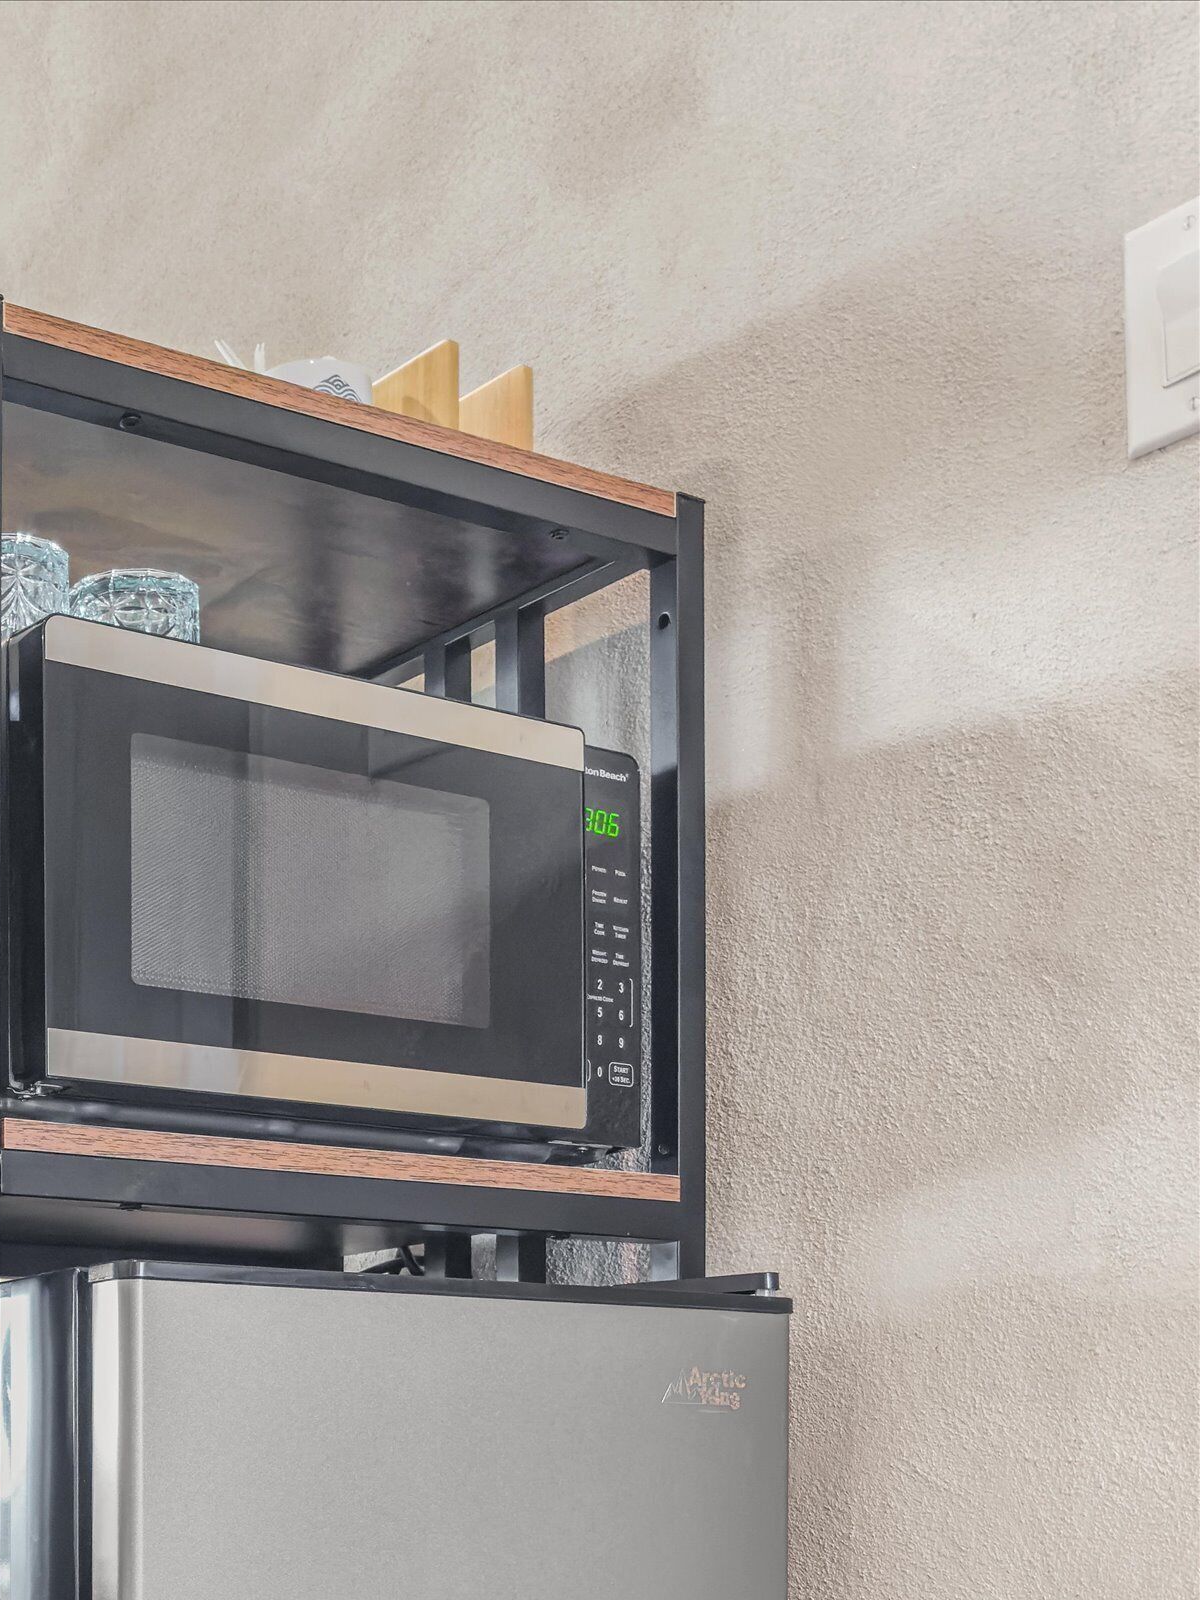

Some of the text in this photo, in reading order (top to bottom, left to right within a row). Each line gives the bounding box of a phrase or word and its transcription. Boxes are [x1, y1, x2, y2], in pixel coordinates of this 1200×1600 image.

[600, 769, 626, 782] Beach
[597, 978, 624, 994] 2 3
[597, 1006, 624, 1021] 5 6
[597, 1034, 624, 1049] 8 9
[597, 1066, 603, 1078] 0
